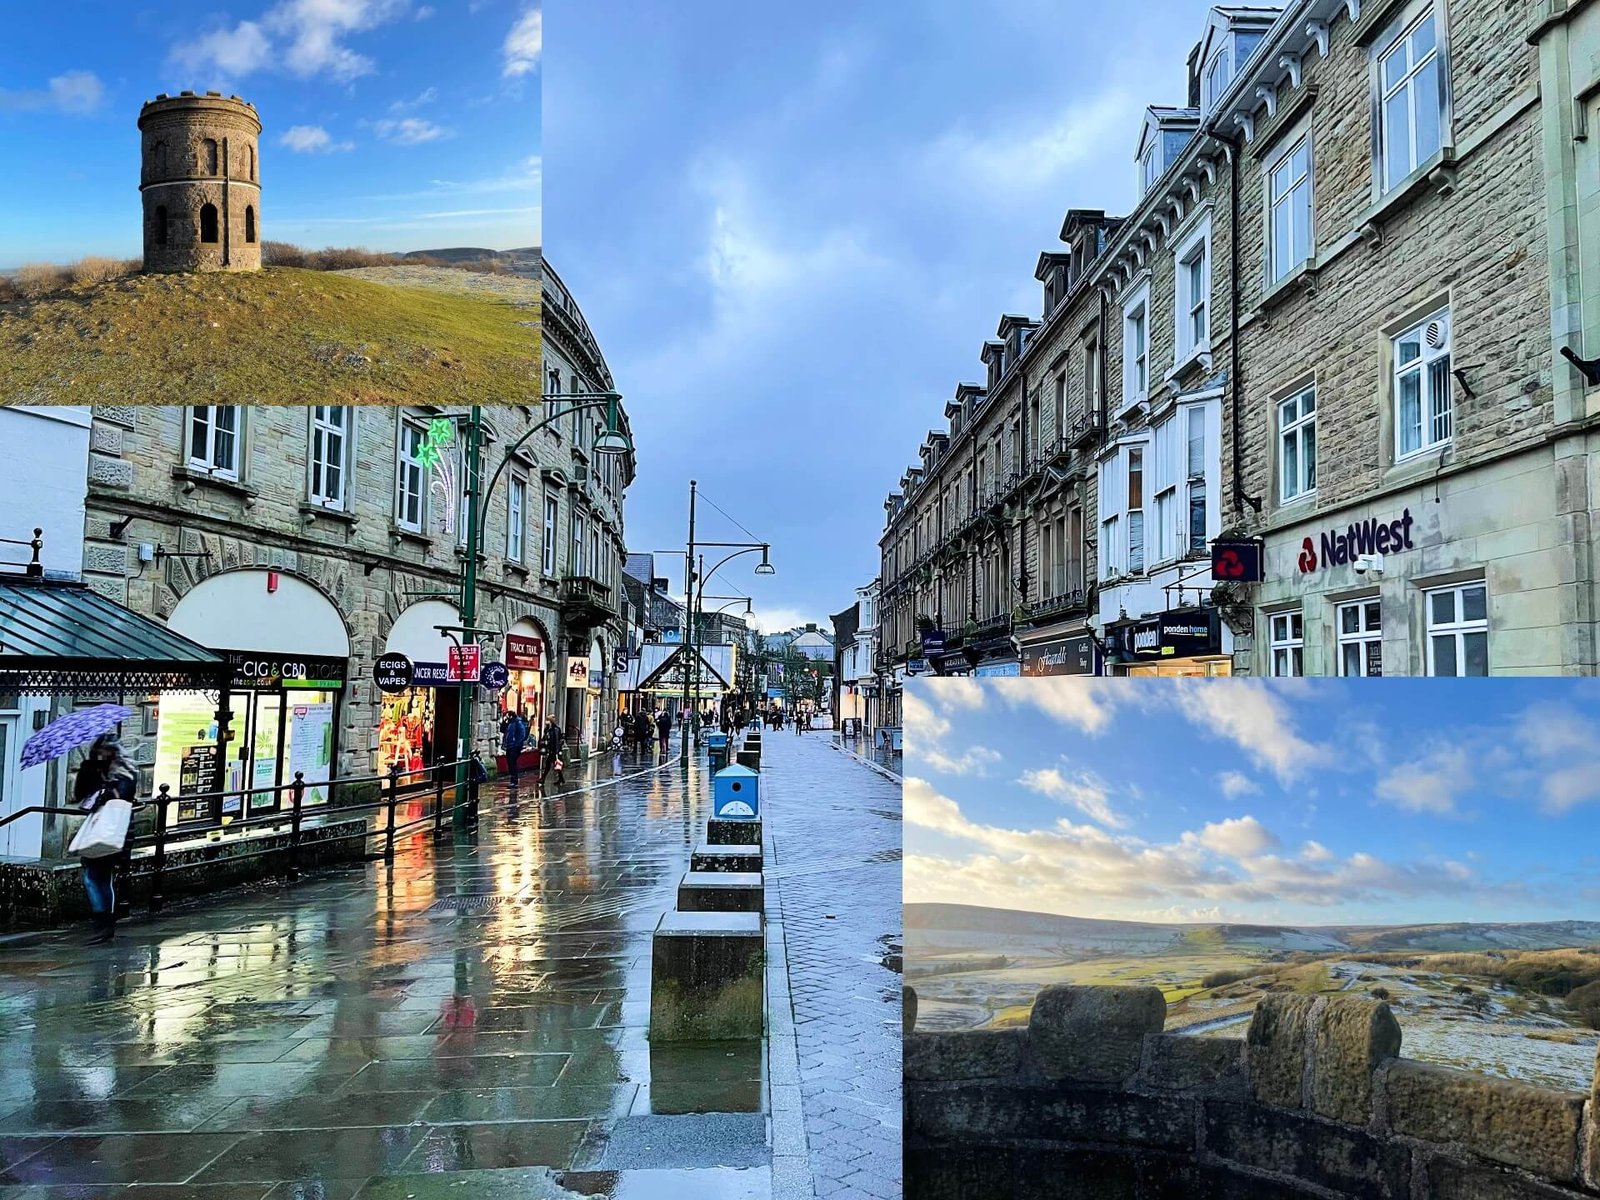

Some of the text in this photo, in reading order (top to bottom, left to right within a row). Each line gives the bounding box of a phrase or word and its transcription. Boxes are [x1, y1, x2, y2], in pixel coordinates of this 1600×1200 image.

[1321, 508, 1413, 568] NatWest
[1163, 625, 1208, 634] ponden home
[1134, 627, 1157, 653] ponden
[510, 642, 538, 655] TRACK TRAIL
[282, 663, 306, 678] CBD
[380, 661, 407, 669] ECIGS
[379, 677, 407, 685] VAPES
